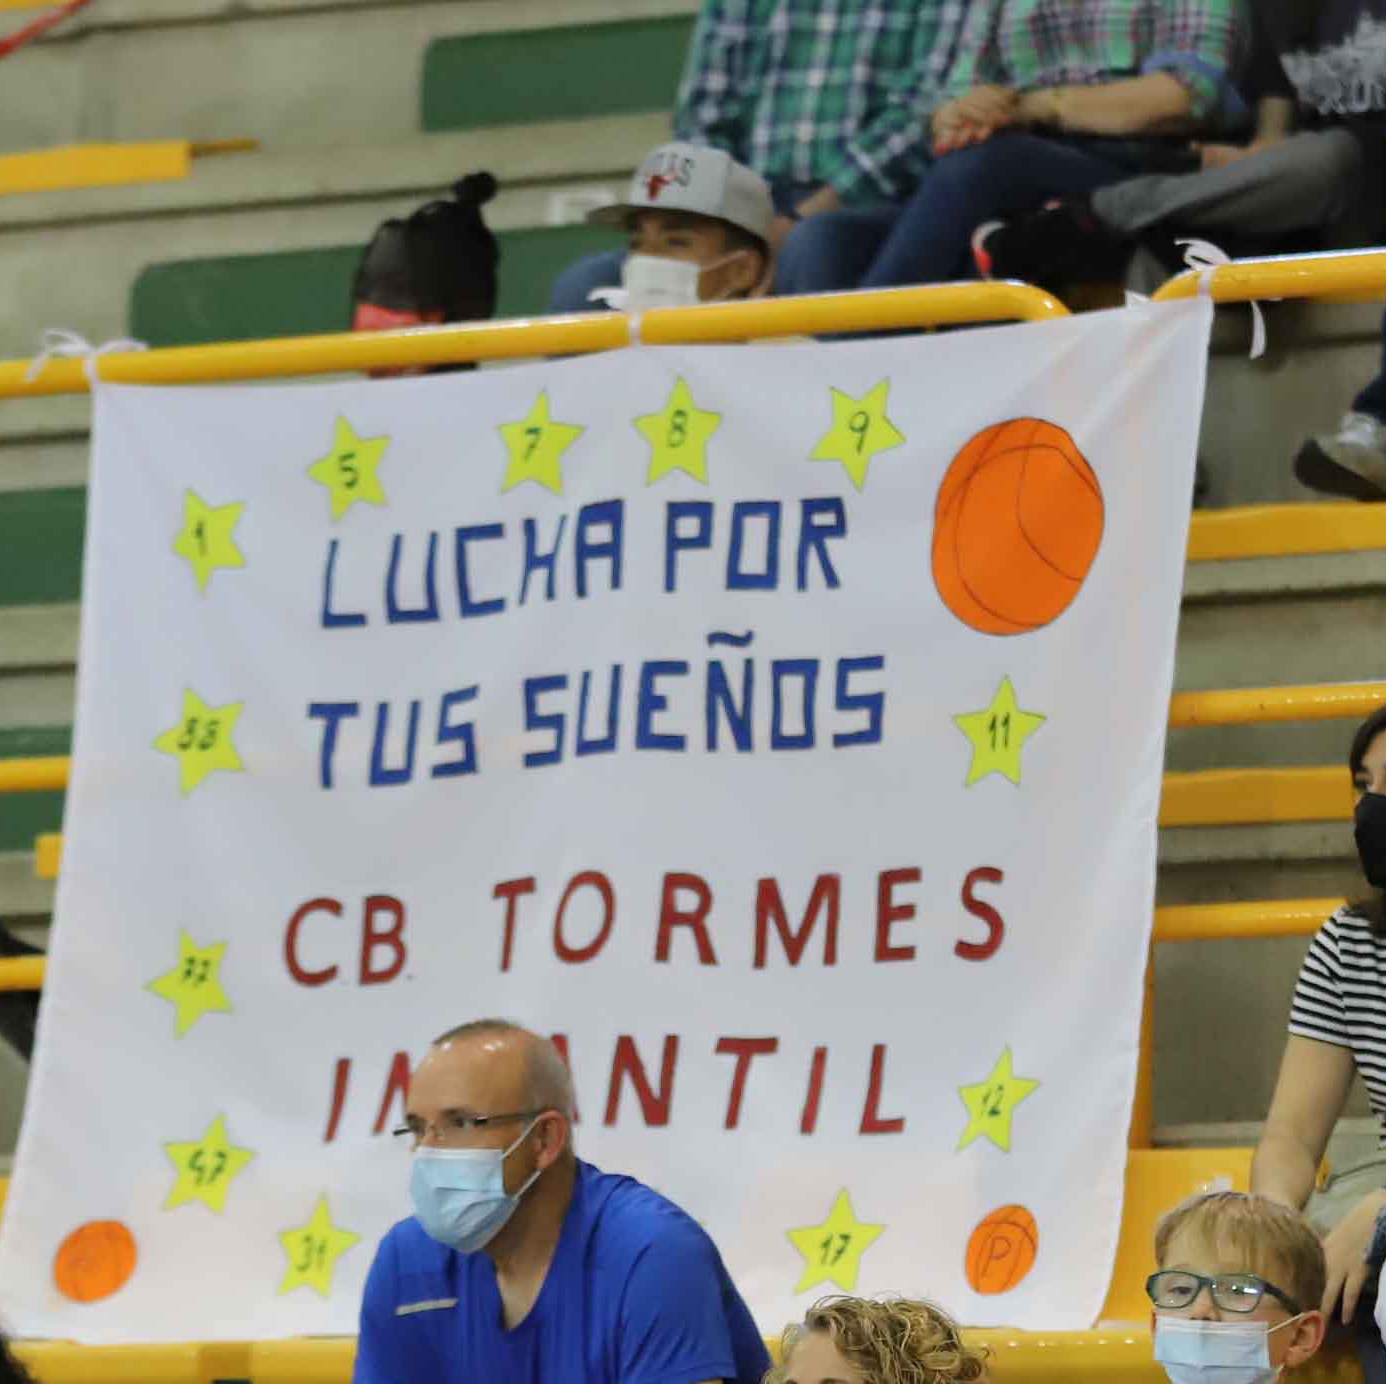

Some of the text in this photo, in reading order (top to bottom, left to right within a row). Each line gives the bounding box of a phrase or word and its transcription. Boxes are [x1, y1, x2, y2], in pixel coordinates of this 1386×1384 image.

[522, 426, 542, 462] 7
[666, 409, 689, 448] 8
[848, 411, 871, 455] 9
[336, 451, 360, 489] 5
[322, 497, 847, 629] LUCHA POR
[308, 630, 886, 790] TUS SUEÑOS
[989, 713, 1011, 752] 11
[284, 867, 1005, 987] CB TORMES
[980, 1084, 1004, 1118] 12
[820, 1232, 852, 1266] 17
